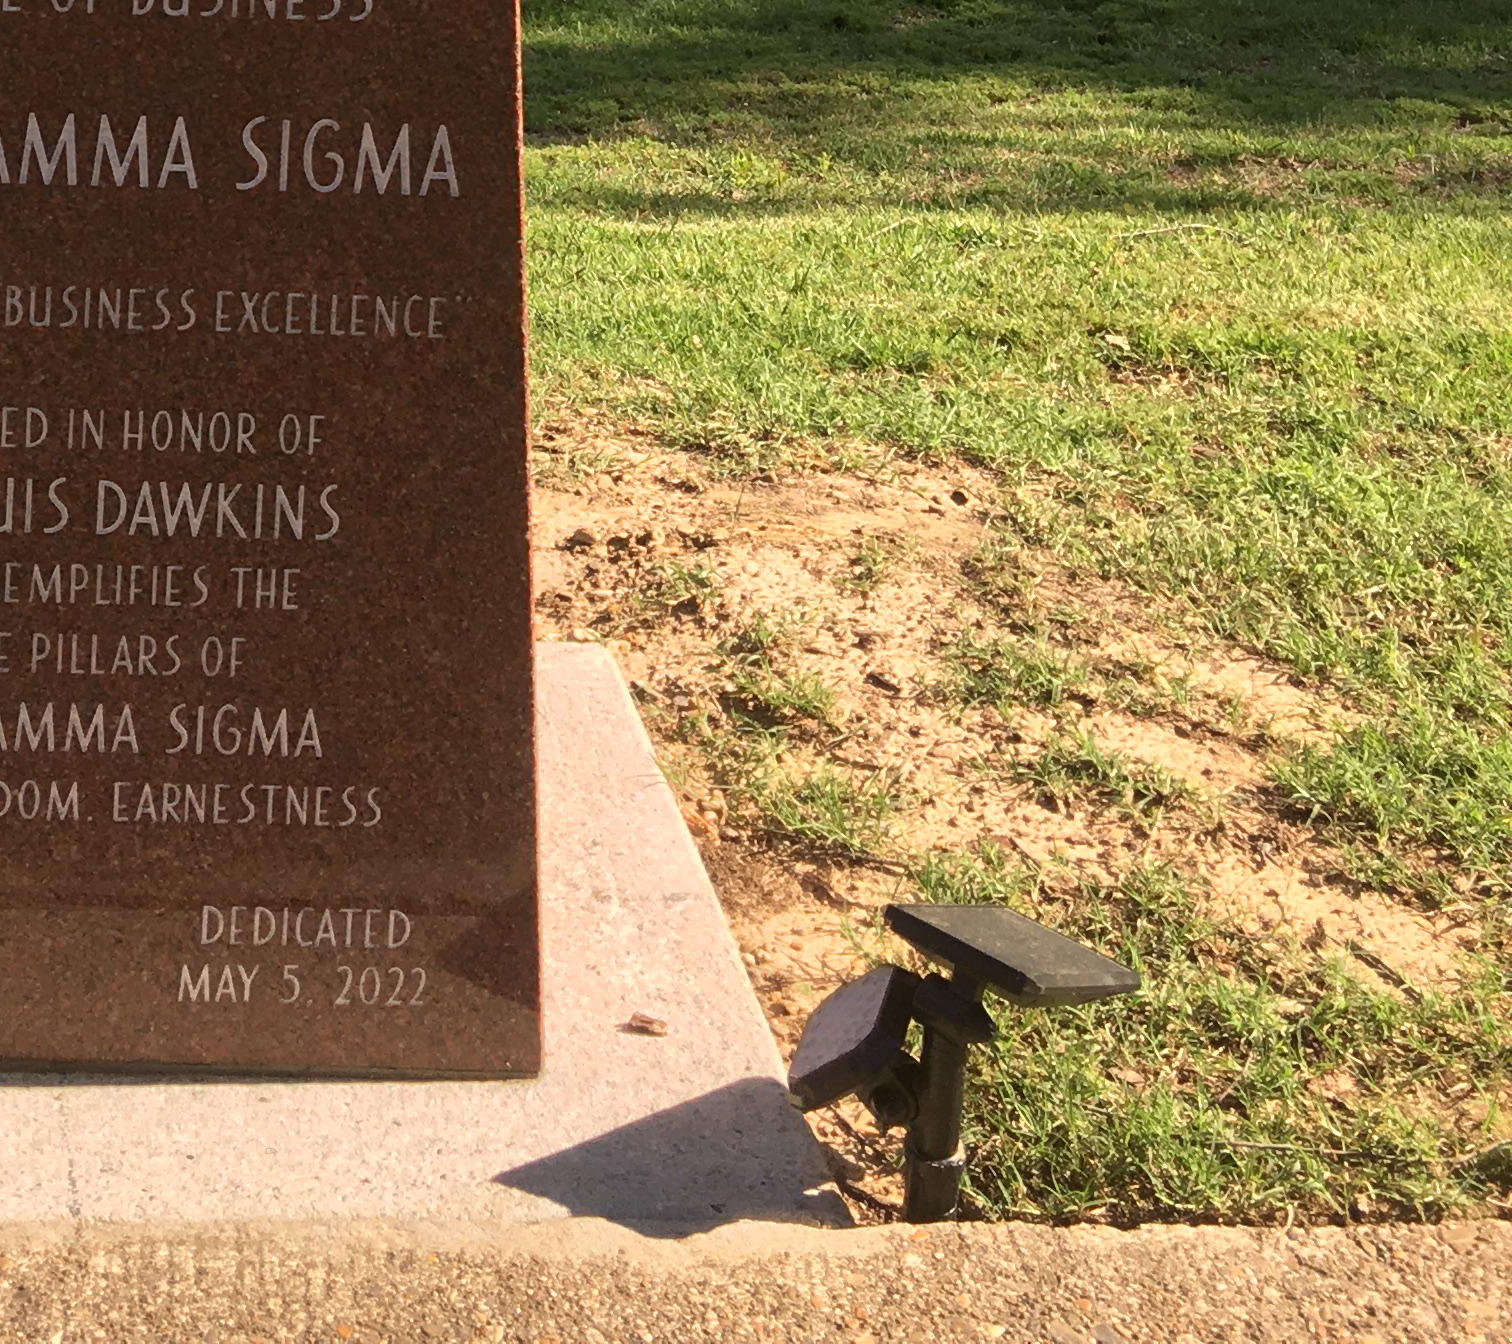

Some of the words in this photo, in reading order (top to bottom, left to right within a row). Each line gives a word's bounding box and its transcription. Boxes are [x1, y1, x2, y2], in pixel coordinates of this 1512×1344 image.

[236, 116, 461, 198] SIGMA
[5, 284, 196, 332] BUSINESS
[68, 409, 104, 450] IN
[122, 410, 256, 454] HONOR
[278, 412, 326, 456] OF
[95, 480, 341, 542] DAWKINS
[230, 568, 301, 610] THE
[31, 633, 182, 677] PILLARS
[201, 636, 246, 679] OF
[166, 704, 324, 759] SIGMA
[111, 781, 383, 828] EARNESTNESS
[200, 905, 411, 949] DEDICATED
[178, 963, 259, 1003] MAY
[335, 965, 427, 1006] 2022
